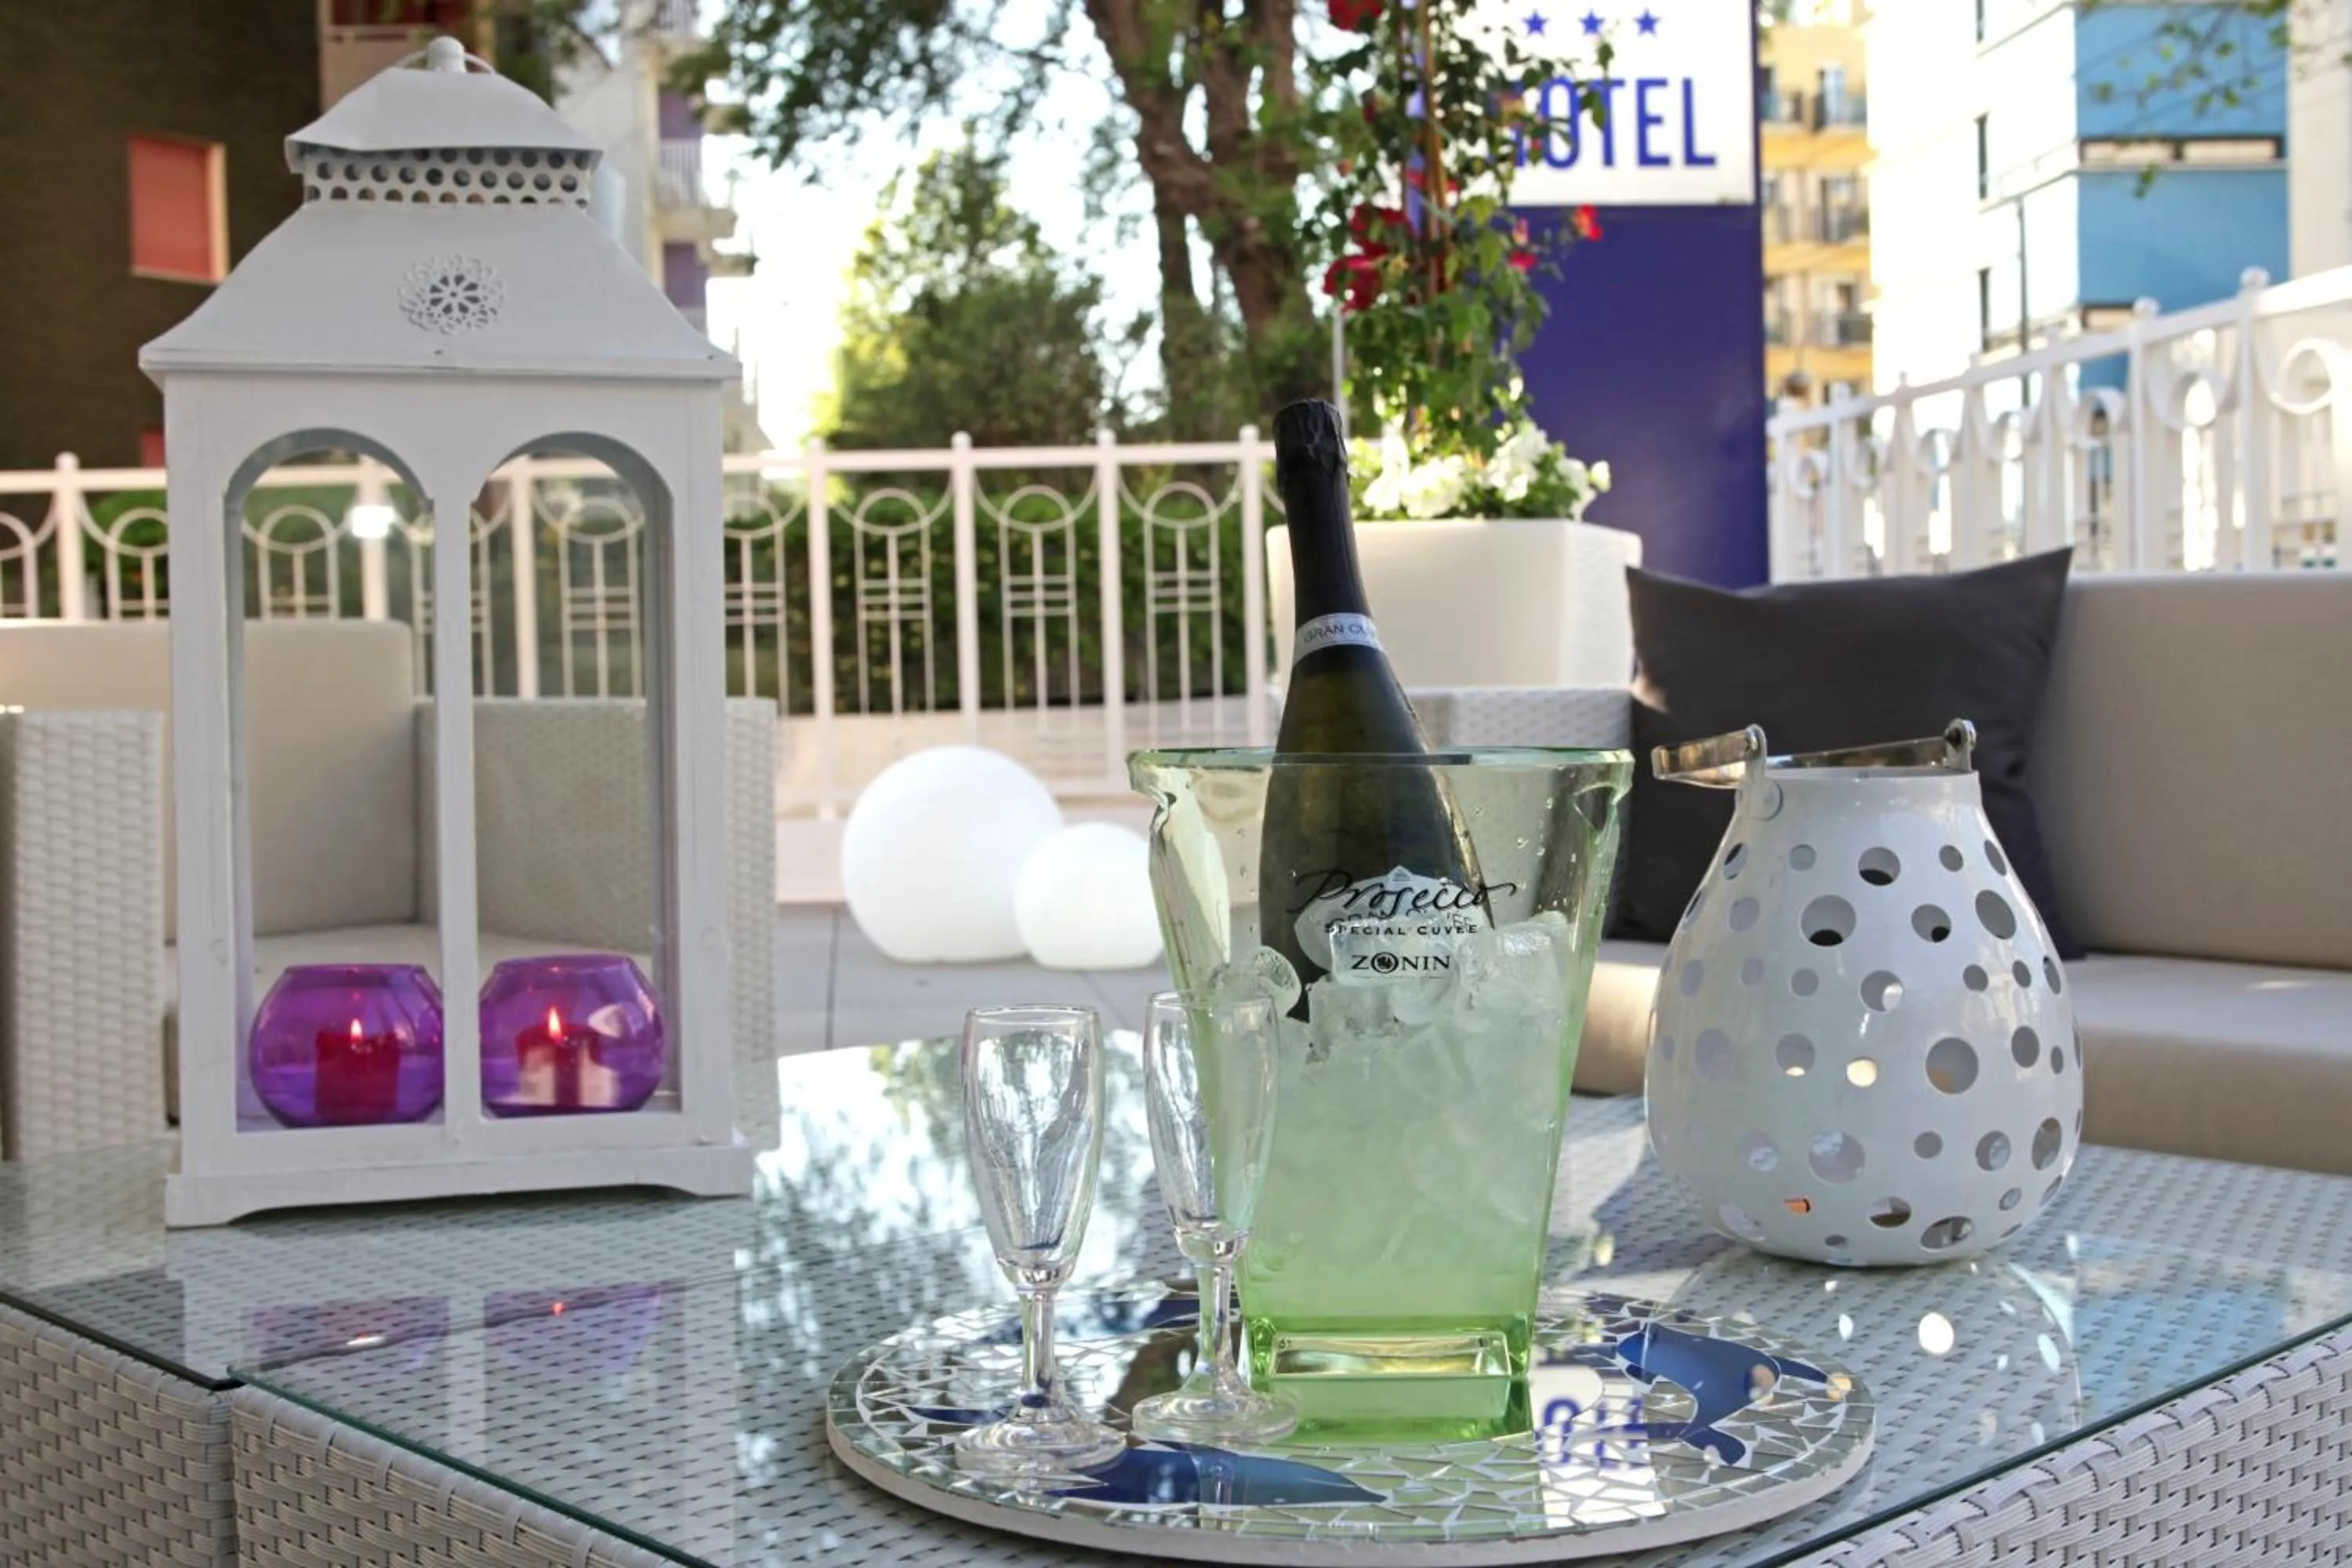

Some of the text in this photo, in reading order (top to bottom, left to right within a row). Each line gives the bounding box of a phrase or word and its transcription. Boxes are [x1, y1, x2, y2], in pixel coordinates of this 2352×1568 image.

[1304, 623, 1345, 642] GRAN
[1286, 869, 1517, 920] Prosecco
[1324, 924, 1406, 936] SPECIAL
[1351, 951, 1450, 975] ZONIN
